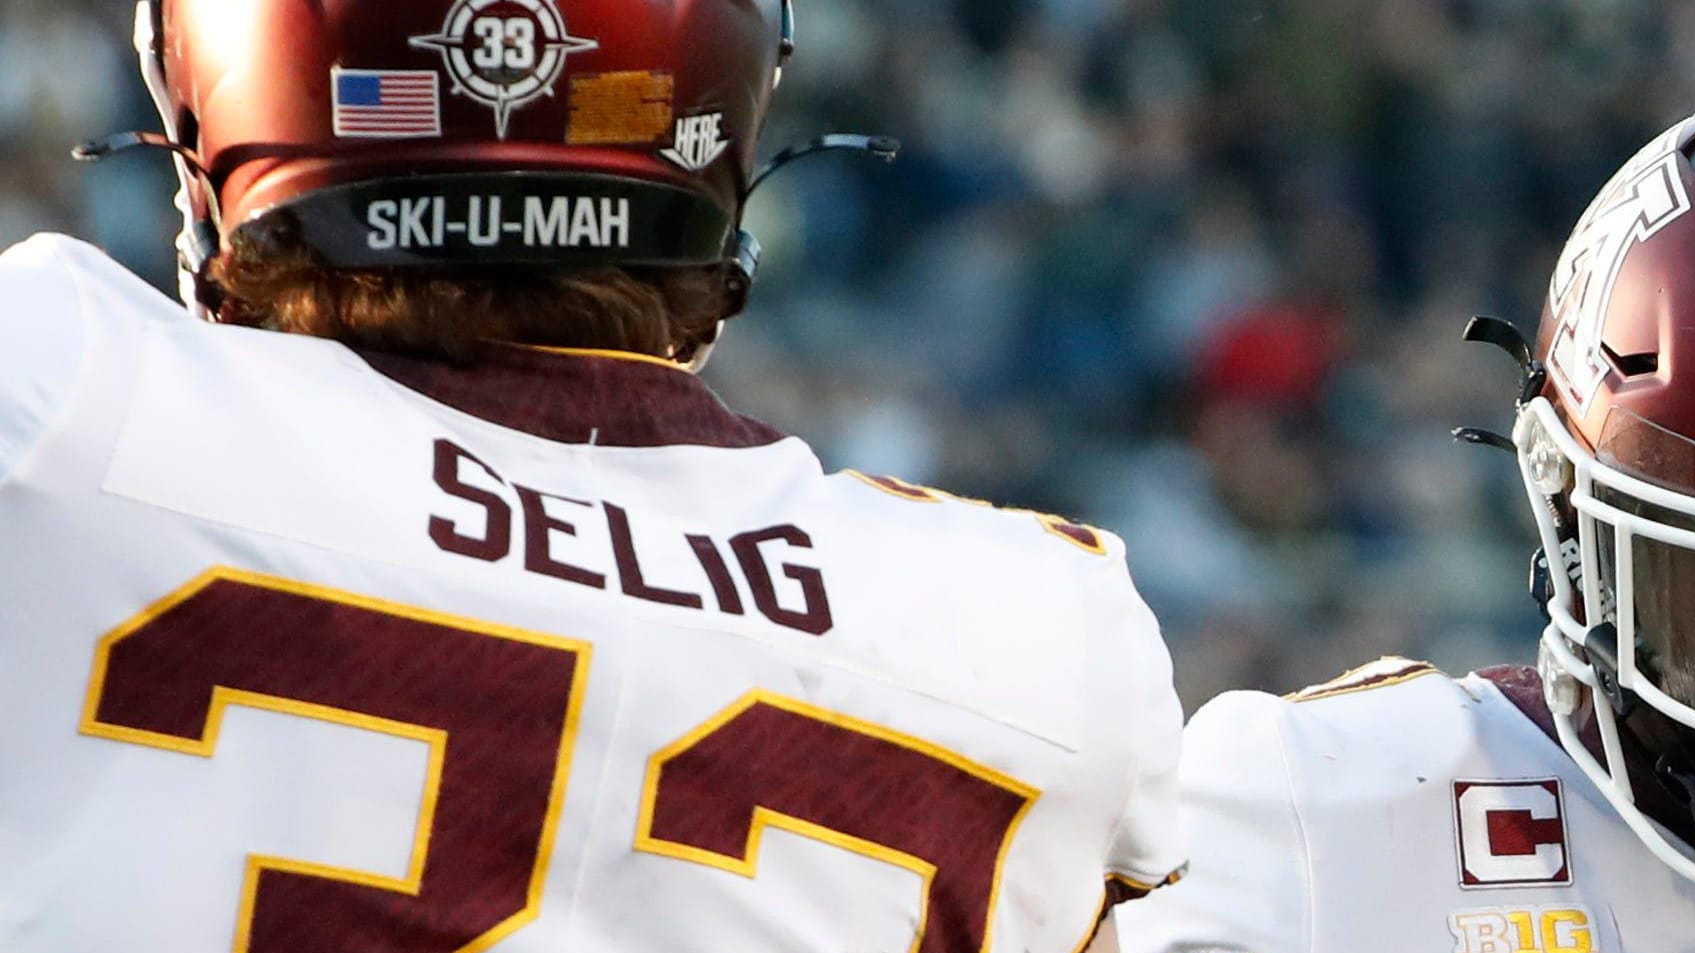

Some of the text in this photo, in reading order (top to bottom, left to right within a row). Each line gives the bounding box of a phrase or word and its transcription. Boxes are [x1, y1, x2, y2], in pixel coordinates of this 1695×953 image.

[473, 16, 535, 69] 33
[367, 196, 629, 250] SKI-U-MAH
[428, 438, 833, 636] SELIG
[1459, 784, 1565, 883] C
